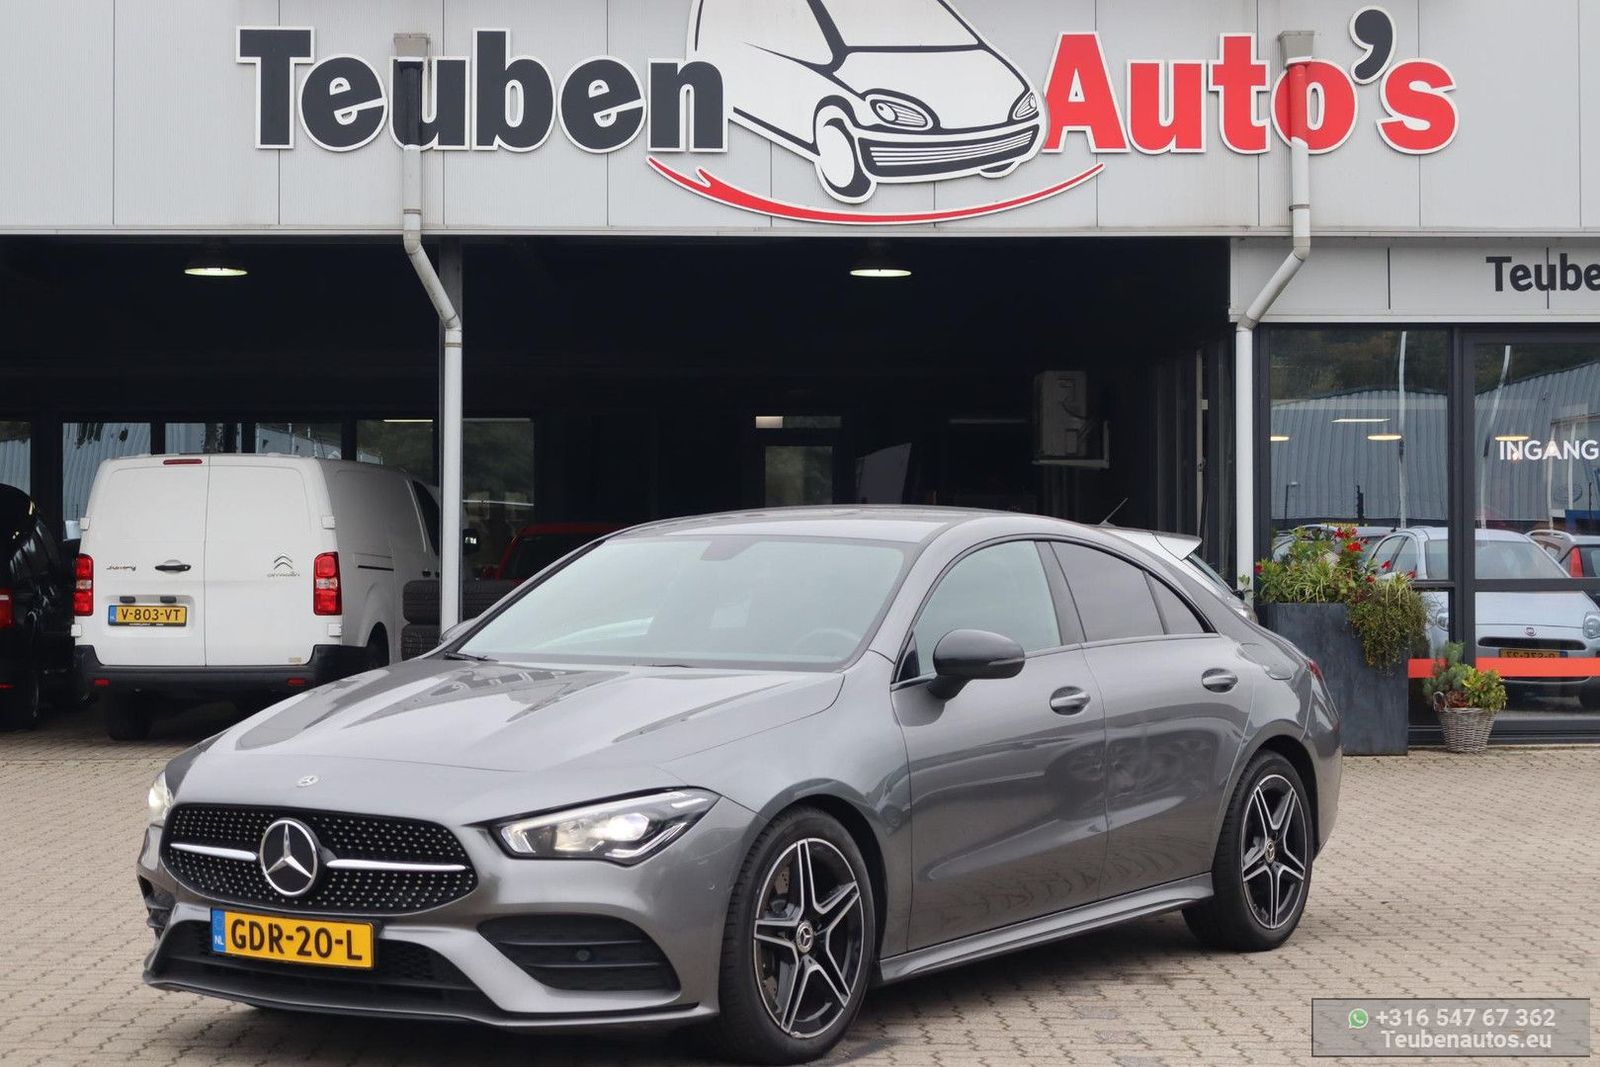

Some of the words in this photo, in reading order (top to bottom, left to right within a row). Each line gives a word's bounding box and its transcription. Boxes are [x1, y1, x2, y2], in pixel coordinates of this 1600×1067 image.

[236, 26, 728, 153] Teuben
[1042, 5, 1459, 154] Auto's
[1486, 253, 1600, 291] Teube
[1500, 440, 1599, 460] INGANG
[121, 608, 180, 621] V-803-VT
[214, 935, 224, 946] NL
[231, 918, 363, 961] GDR-20-L
